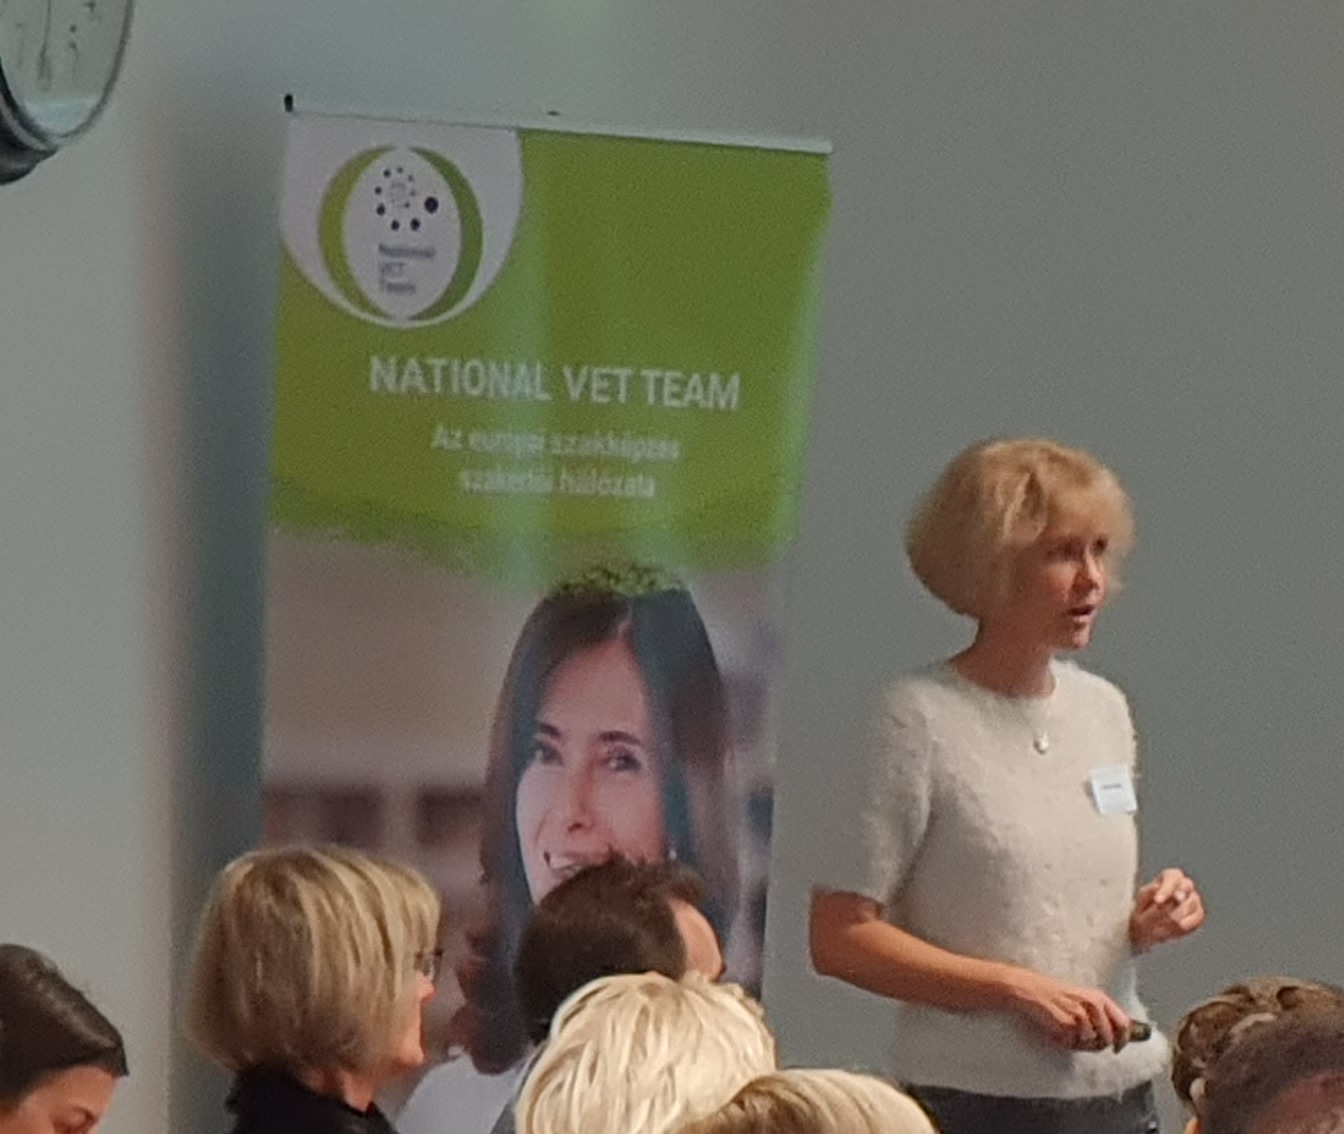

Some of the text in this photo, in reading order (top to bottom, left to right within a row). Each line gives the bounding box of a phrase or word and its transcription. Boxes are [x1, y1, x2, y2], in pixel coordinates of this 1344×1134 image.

[369, 355, 741, 410] NATIONAL VET TEAM
